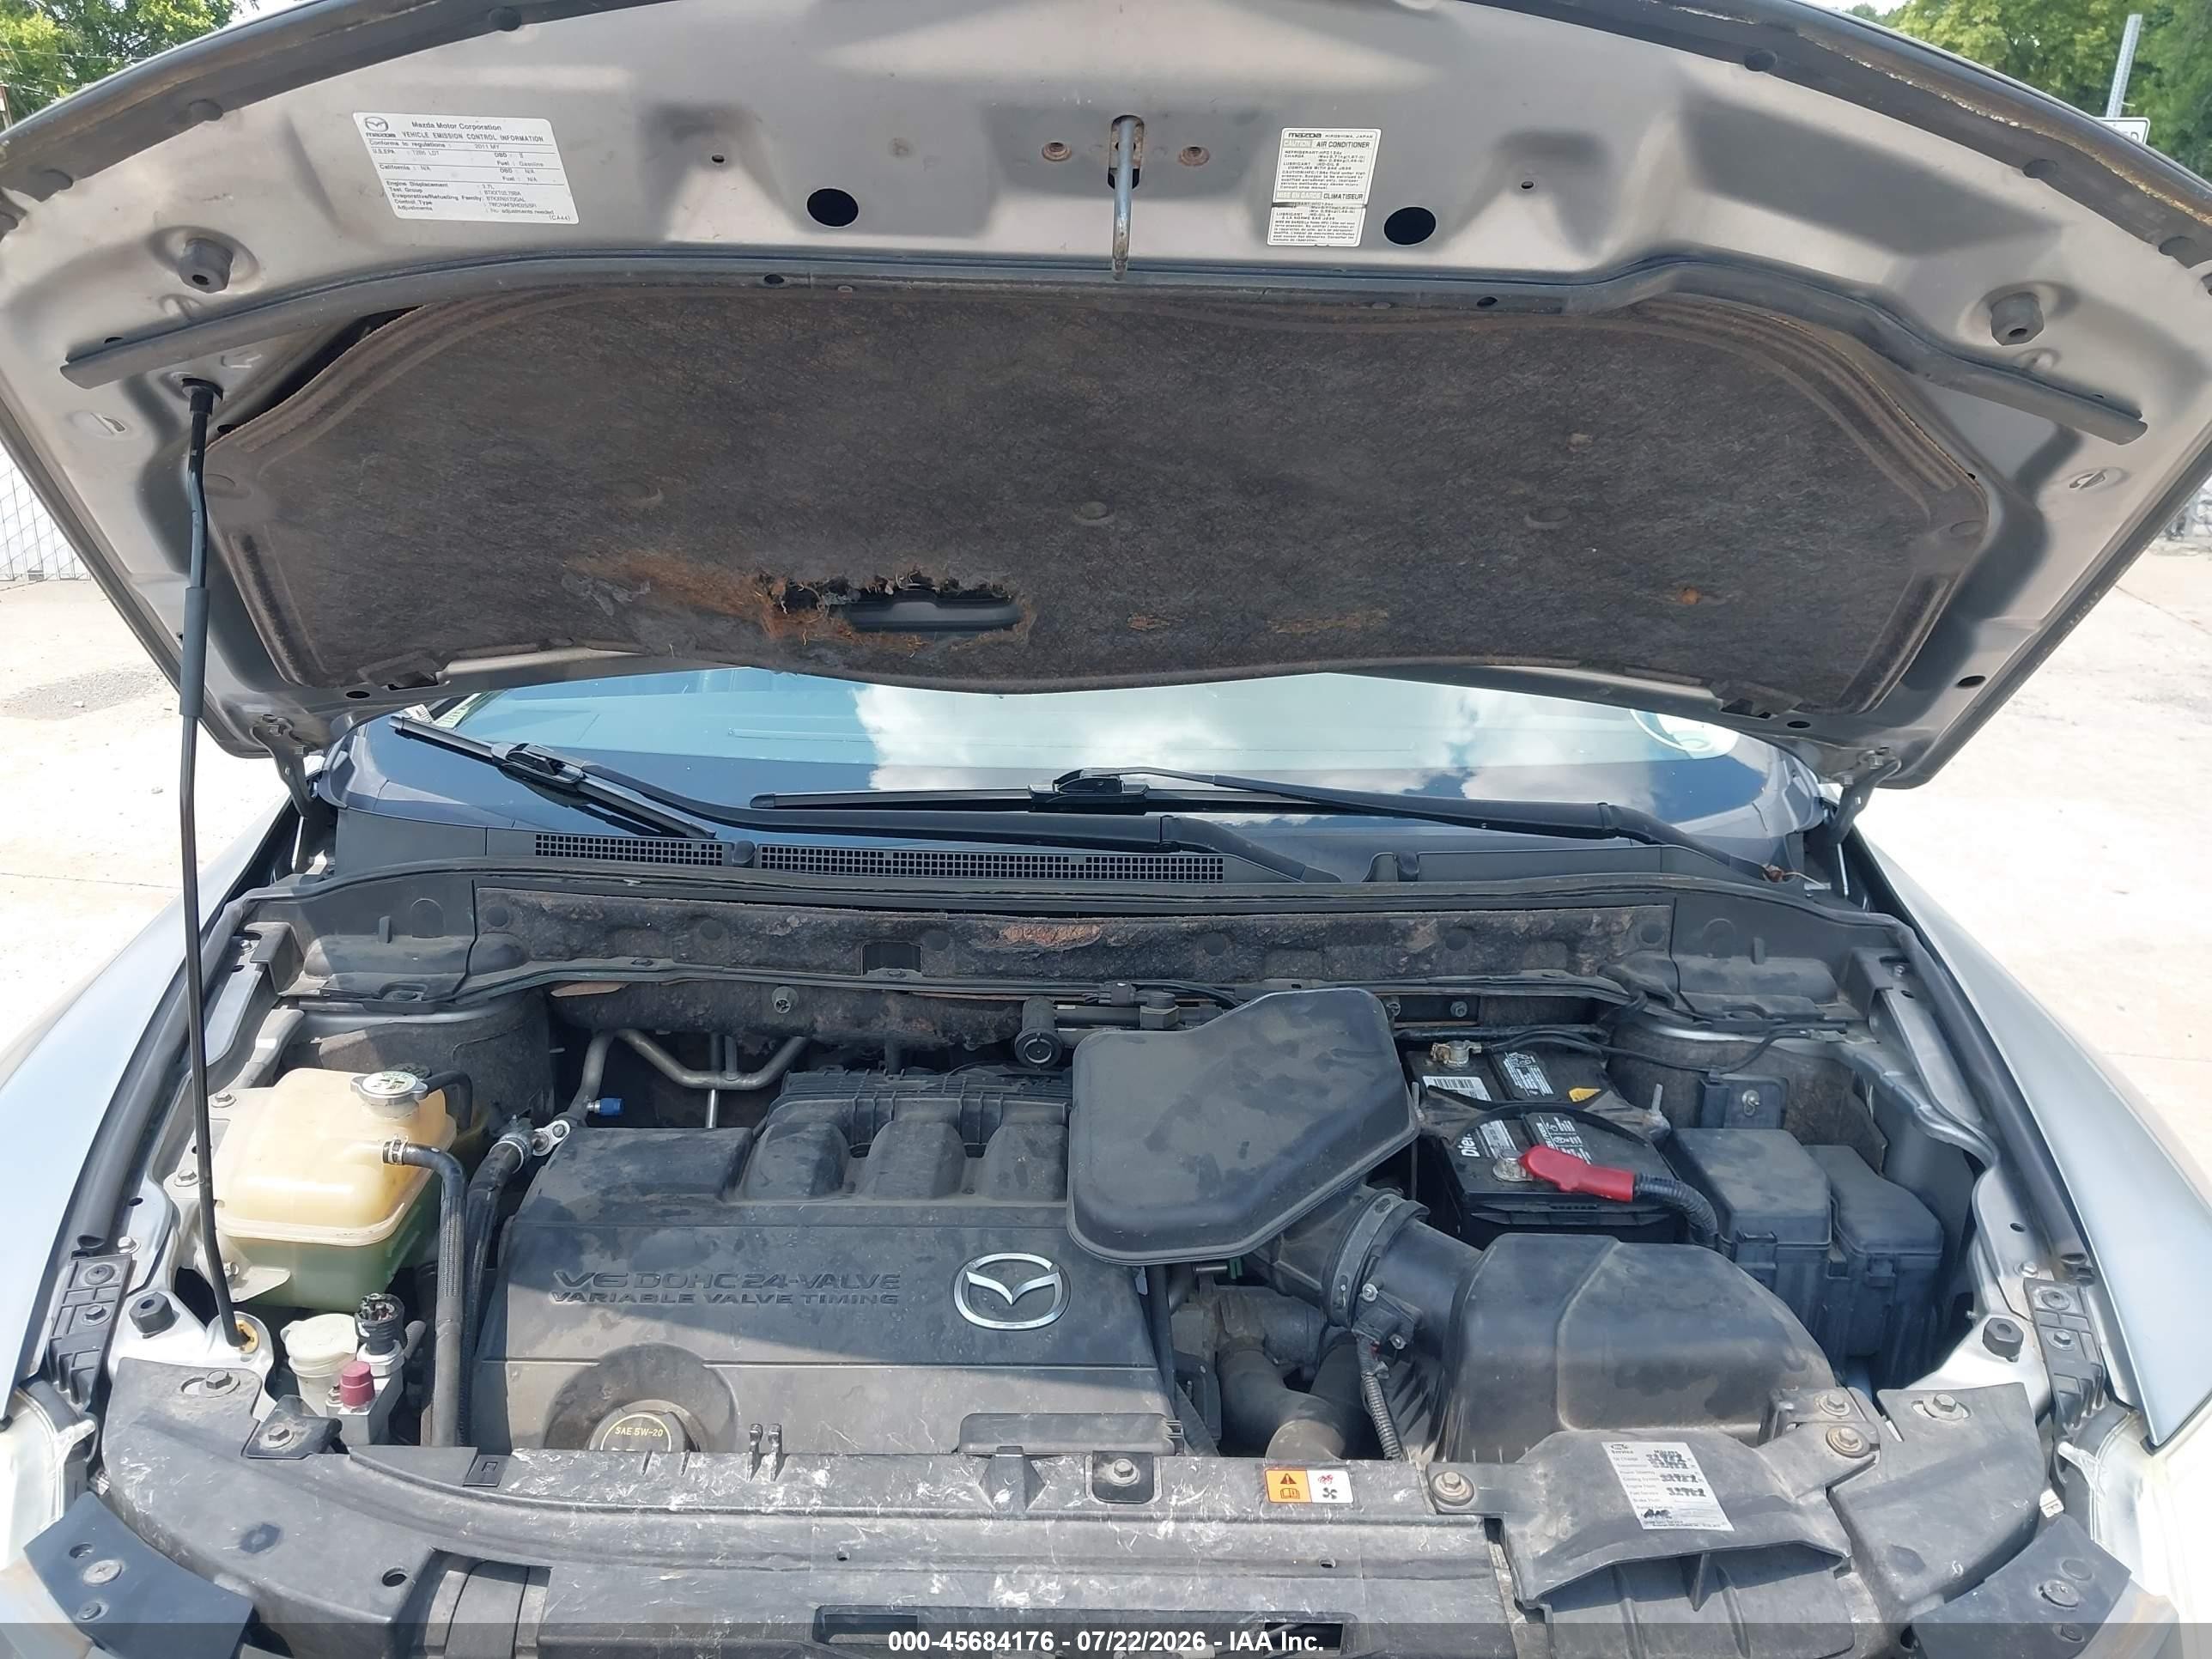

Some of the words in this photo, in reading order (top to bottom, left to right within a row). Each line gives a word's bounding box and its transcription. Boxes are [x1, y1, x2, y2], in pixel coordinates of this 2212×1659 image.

[554, 1271, 629, 1289] V6
[633, 1272, 738, 1289] DOHC
[741, 1273, 901, 1290] 24-VALVE
[550, 1291, 696, 1304] VARIABLE
[703, 1292, 793, 1305] VALVE
[800, 1293, 899, 1305] TIMING
[615, 1426, 632, 1436] SAE
[634, 1427, 664, 1437] 5W-20
